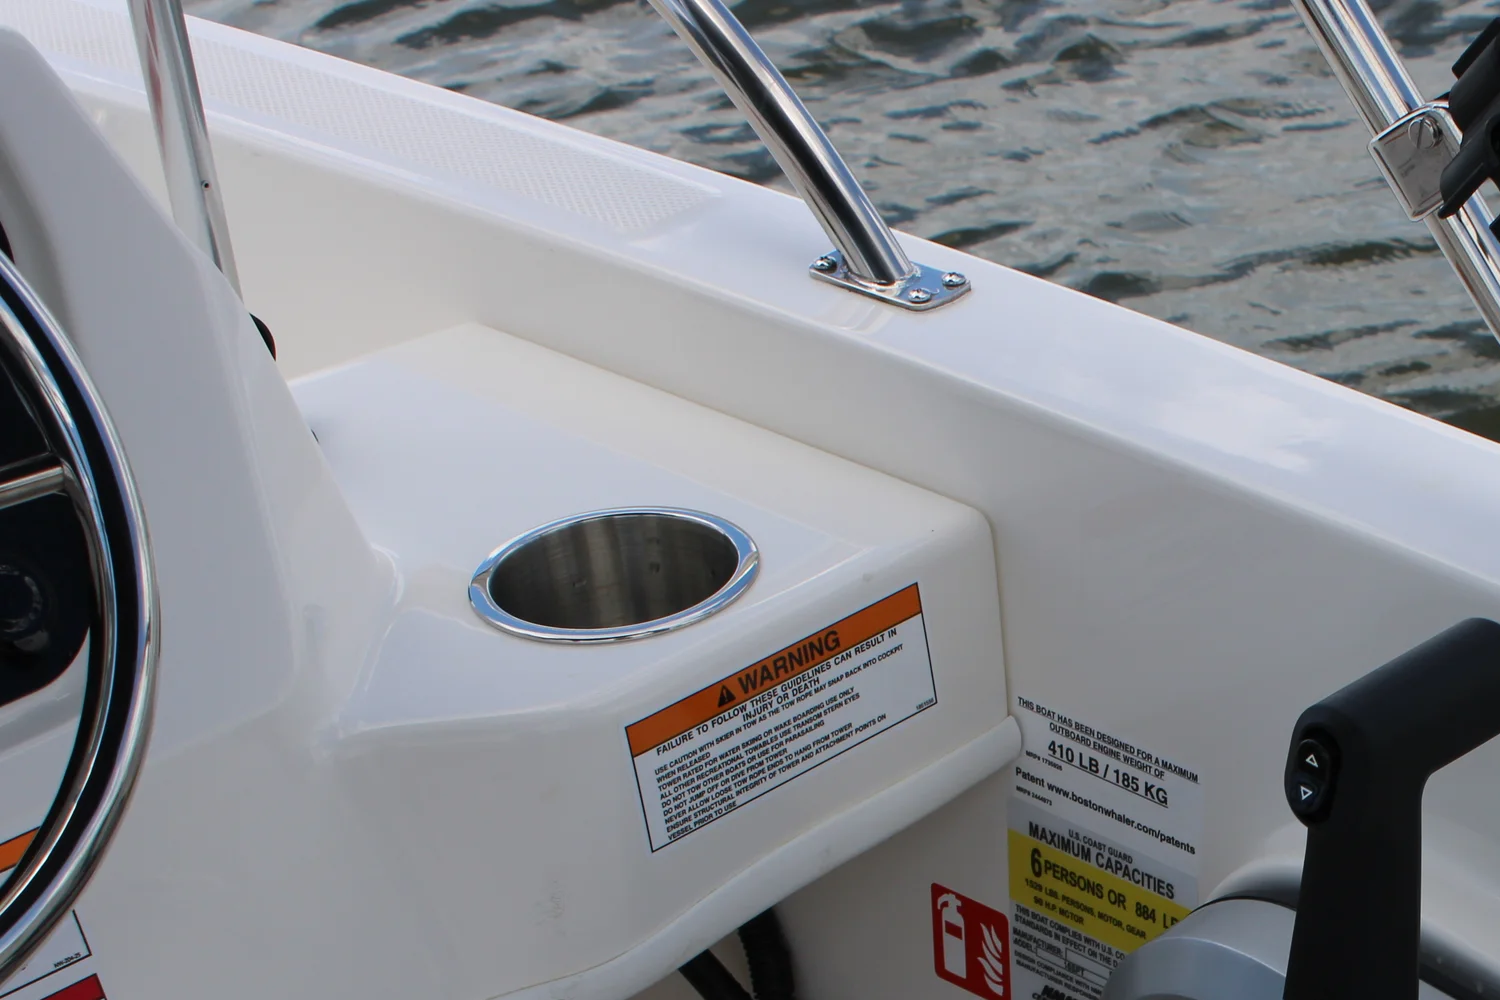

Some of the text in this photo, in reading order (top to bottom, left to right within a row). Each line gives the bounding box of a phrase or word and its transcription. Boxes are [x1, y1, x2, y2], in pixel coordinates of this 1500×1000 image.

[656, 628, 897, 756] FAILURE TO FOLLOW THESE GUIDELINES CAN RESULT IN
[738, 630, 840, 694] WARNING
[654, 643, 902, 775] USE CAUTION WITH SKIER IN TOW AS THE TOW ROPE MAY SNAP BACK INTO COCKPIT
[742, 676, 819, 722] INJURY OR DEATH
[656, 752, 710, 783] WHEN RELEASED
[658, 687, 854, 791] TOWER RATED FOR WATER SKIING OR WAKE BOARDING USE ONLY
[660, 692, 860, 800] ALL OTHER RECREATIONAL TOWABLES USE TRANSOM STERN EYES
[661, 719, 824, 808] DO NOT TOW OTHER BOATS OR USE FOR PARASAILING
[665, 722, 852, 824] NEVER ALLOW LOOSE TOW ROPE ENDS TO HANG FROM TOWER
[666, 714, 886, 832] ENSURE STRUCTURAL INTEGRITY OF TOWER AND ATTACHMENT POINTS ON
[1018, 696, 1197, 782] THIS BOAT HAS BEEN DESIGNED FOR A MAXIMUM
[1048, 740, 1074, 763] 410
[1079, 752, 1099, 774] LB
[1103, 764, 1109, 778] /
[1113, 769, 1139, 792] 185
[1144, 781, 1167, 805] KG
[1049, 722, 1164, 779] OUTBOARD ENGINE WEIGHT OF
[663, 748, 787, 816] DO NOT JUMP OFF OR DIVE FROM TOWER
[1015, 766, 1044, 787] Patent
[1046, 782, 1195, 854] www.bostonwhaler.com/patents
[668, 800, 736, 840] VESSEL PRIOR TO USE
[1068, 829, 1132, 864] U.S. COAST GUARD
[1029, 821, 1174, 899] MAXIMUM CAPACITIES
[1031, 848, 1042, 878] 6
[1044, 859, 1103, 899] PERSONS
[1107, 889, 1126, 910] OR
[1135, 901, 1156, 923] 884
[1014, 913, 1111, 965] STANDARDS IN EFFECT ON THE
[1016, 904, 1029, 917] THIS
[1031, 911, 1048, 925] BOAT
[1049, 920, 1082, 941] COMPLIES
[1083, 936, 1100, 949] WITH
[1101, 944, 1113, 956] U.S.
[1059, 907, 1083, 924] MOTOR
[1062, 894, 1095, 917] PERSONS,
[1097, 911, 1124, 930] MOTOR,
[1126, 924, 1146, 939] GEAR
